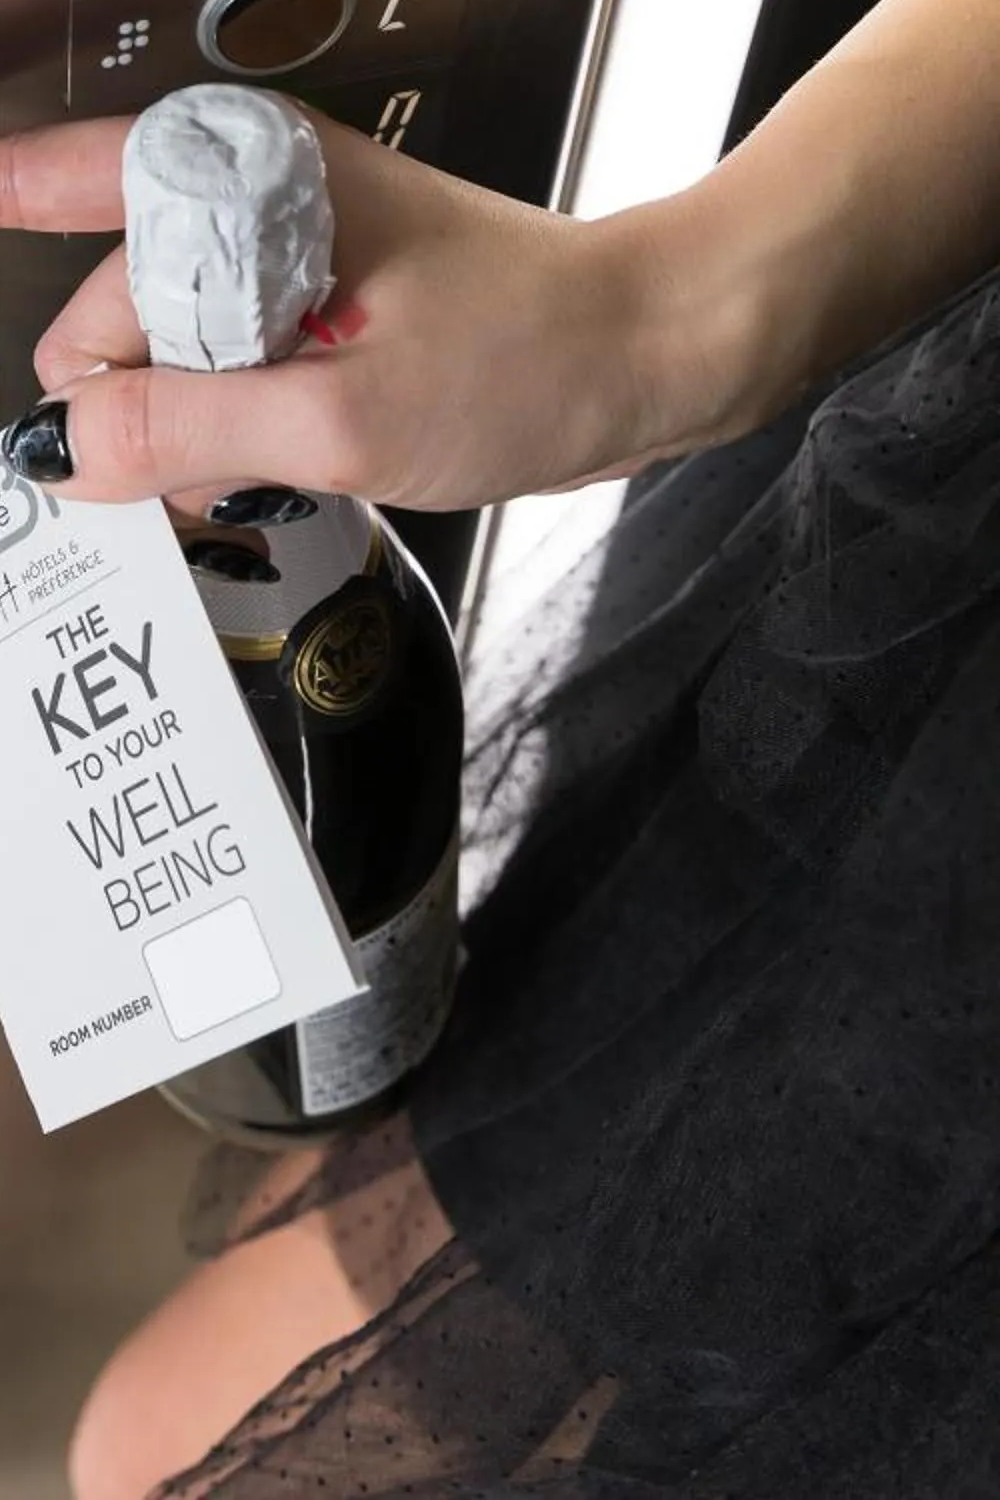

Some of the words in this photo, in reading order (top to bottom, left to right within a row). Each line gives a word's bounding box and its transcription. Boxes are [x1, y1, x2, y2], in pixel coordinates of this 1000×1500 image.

[45, 604, 110, 660] THE
[31, 621, 159, 756] KEY
[65, 753, 104, 790] TO
[104, 710, 183, 767] YOUR
[66, 763, 219, 870] WELL
[103, 823, 247, 932] BEING
[49, 1025, 92, 1057] ROOM
[92, 995, 153, 1036] NUMBER
